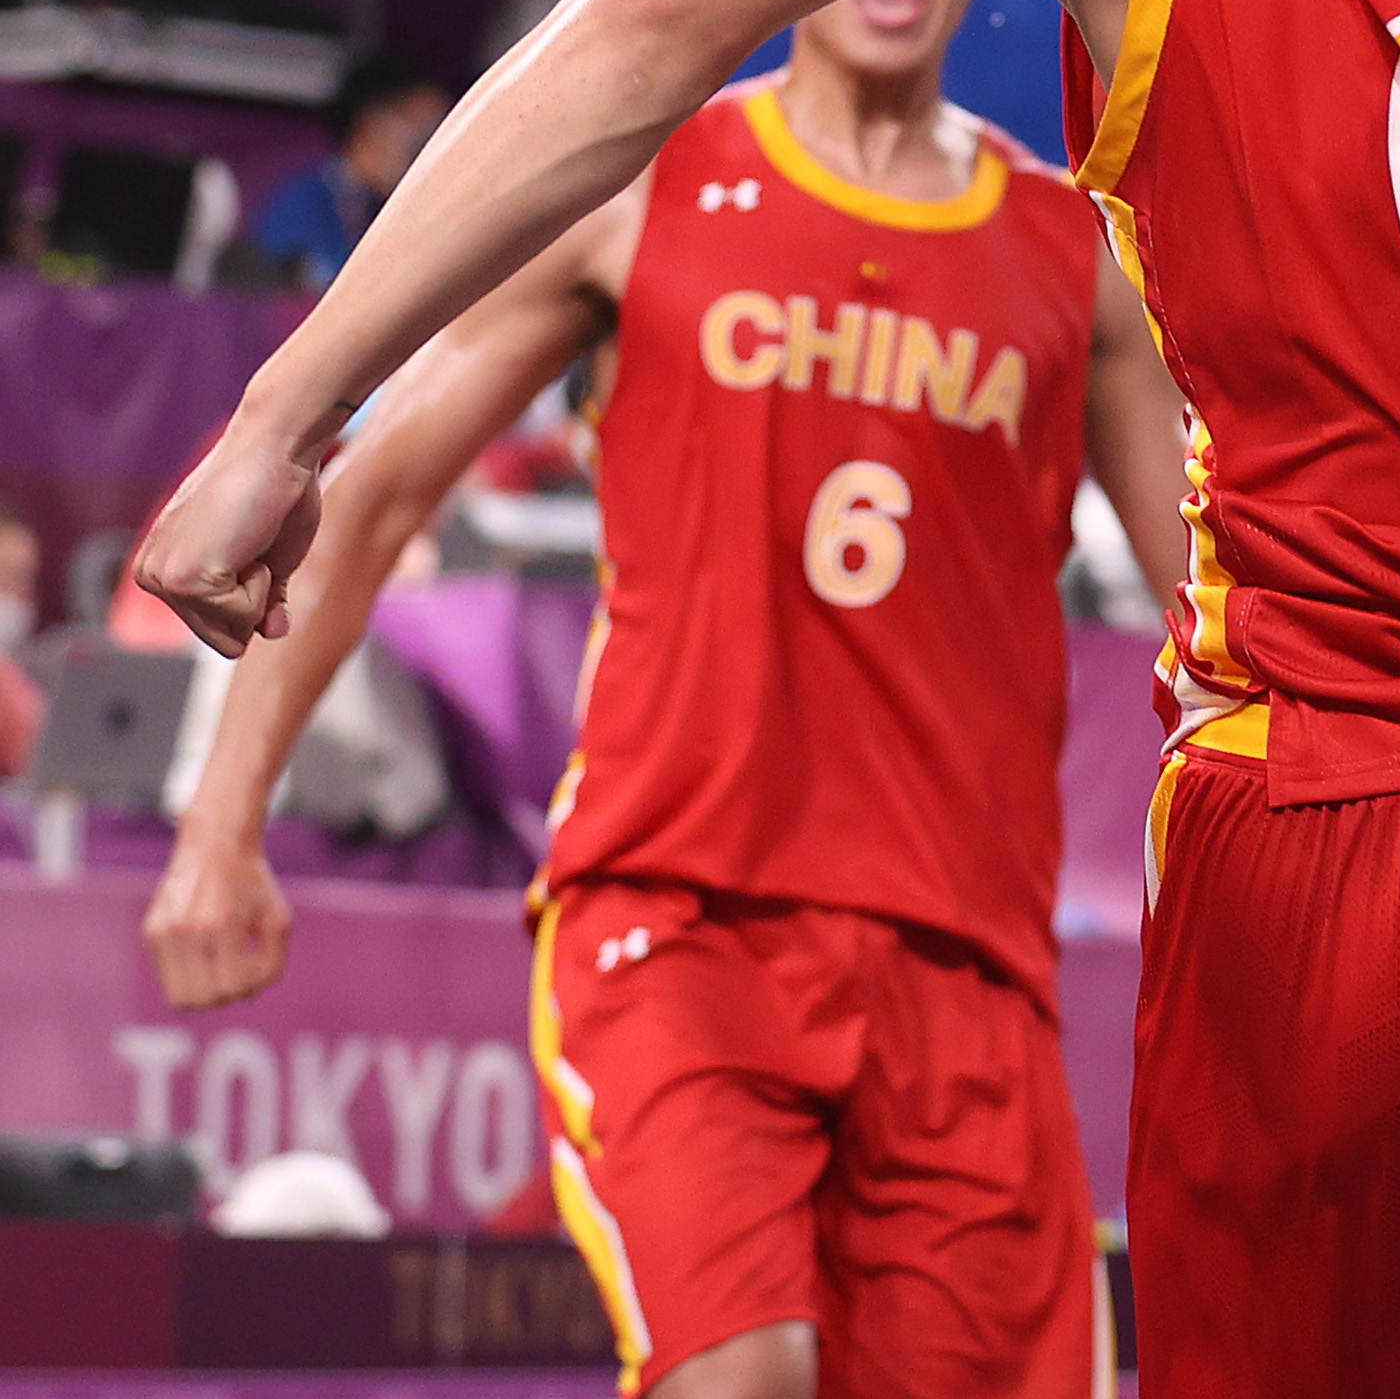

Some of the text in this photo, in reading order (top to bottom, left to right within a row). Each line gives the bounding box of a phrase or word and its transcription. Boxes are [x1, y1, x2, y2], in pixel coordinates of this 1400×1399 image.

[699, 290, 1028, 450] CHINA
[802, 459, 913, 608] 6
[115, 1024, 537, 1214] TOKYO
